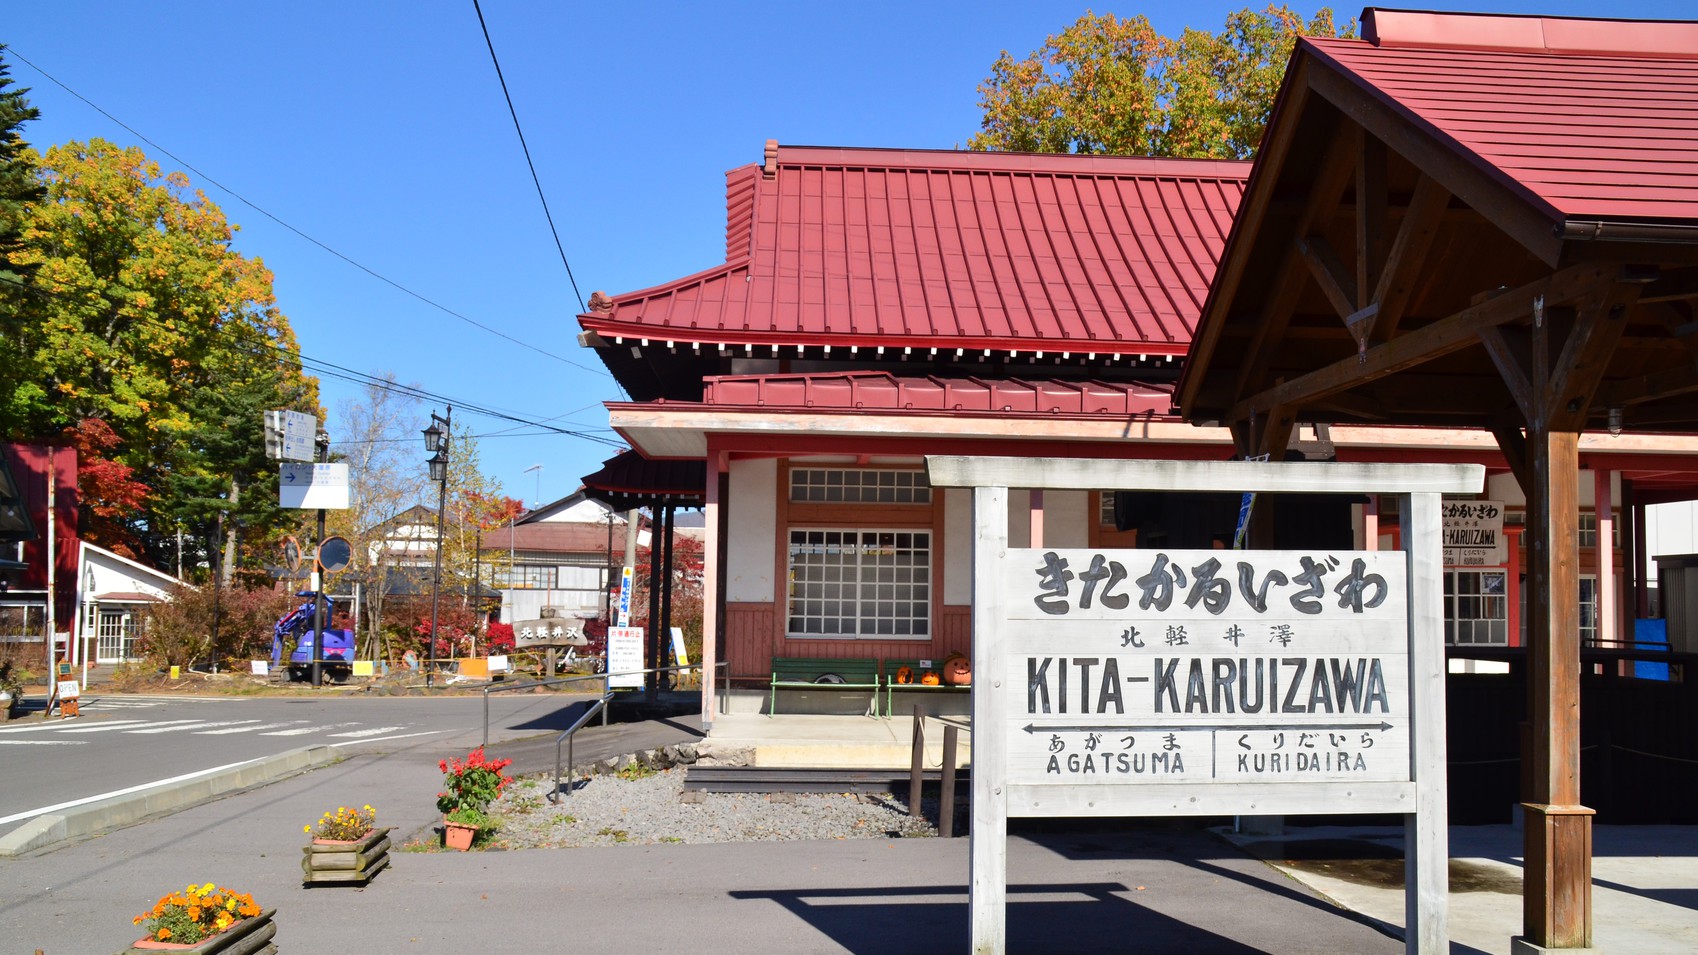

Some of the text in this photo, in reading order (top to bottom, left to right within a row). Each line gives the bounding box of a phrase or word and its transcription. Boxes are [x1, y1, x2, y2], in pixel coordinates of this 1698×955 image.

[1034, 552, 1387, 615] きたかるいざわ
[520, 626, 579, 640] 北軽井沢
[60, 683, 77, 693] OPEN
[1028, 658, 1389, 714] KITA-KARUIZAWA
[1048, 733, 1182, 751] あがつま
[1239, 733, 1373, 750] くりだいら
[1047, 753, 1183, 774] AGATSUMA
[1238, 752, 1367, 772] KURIDAIRA
